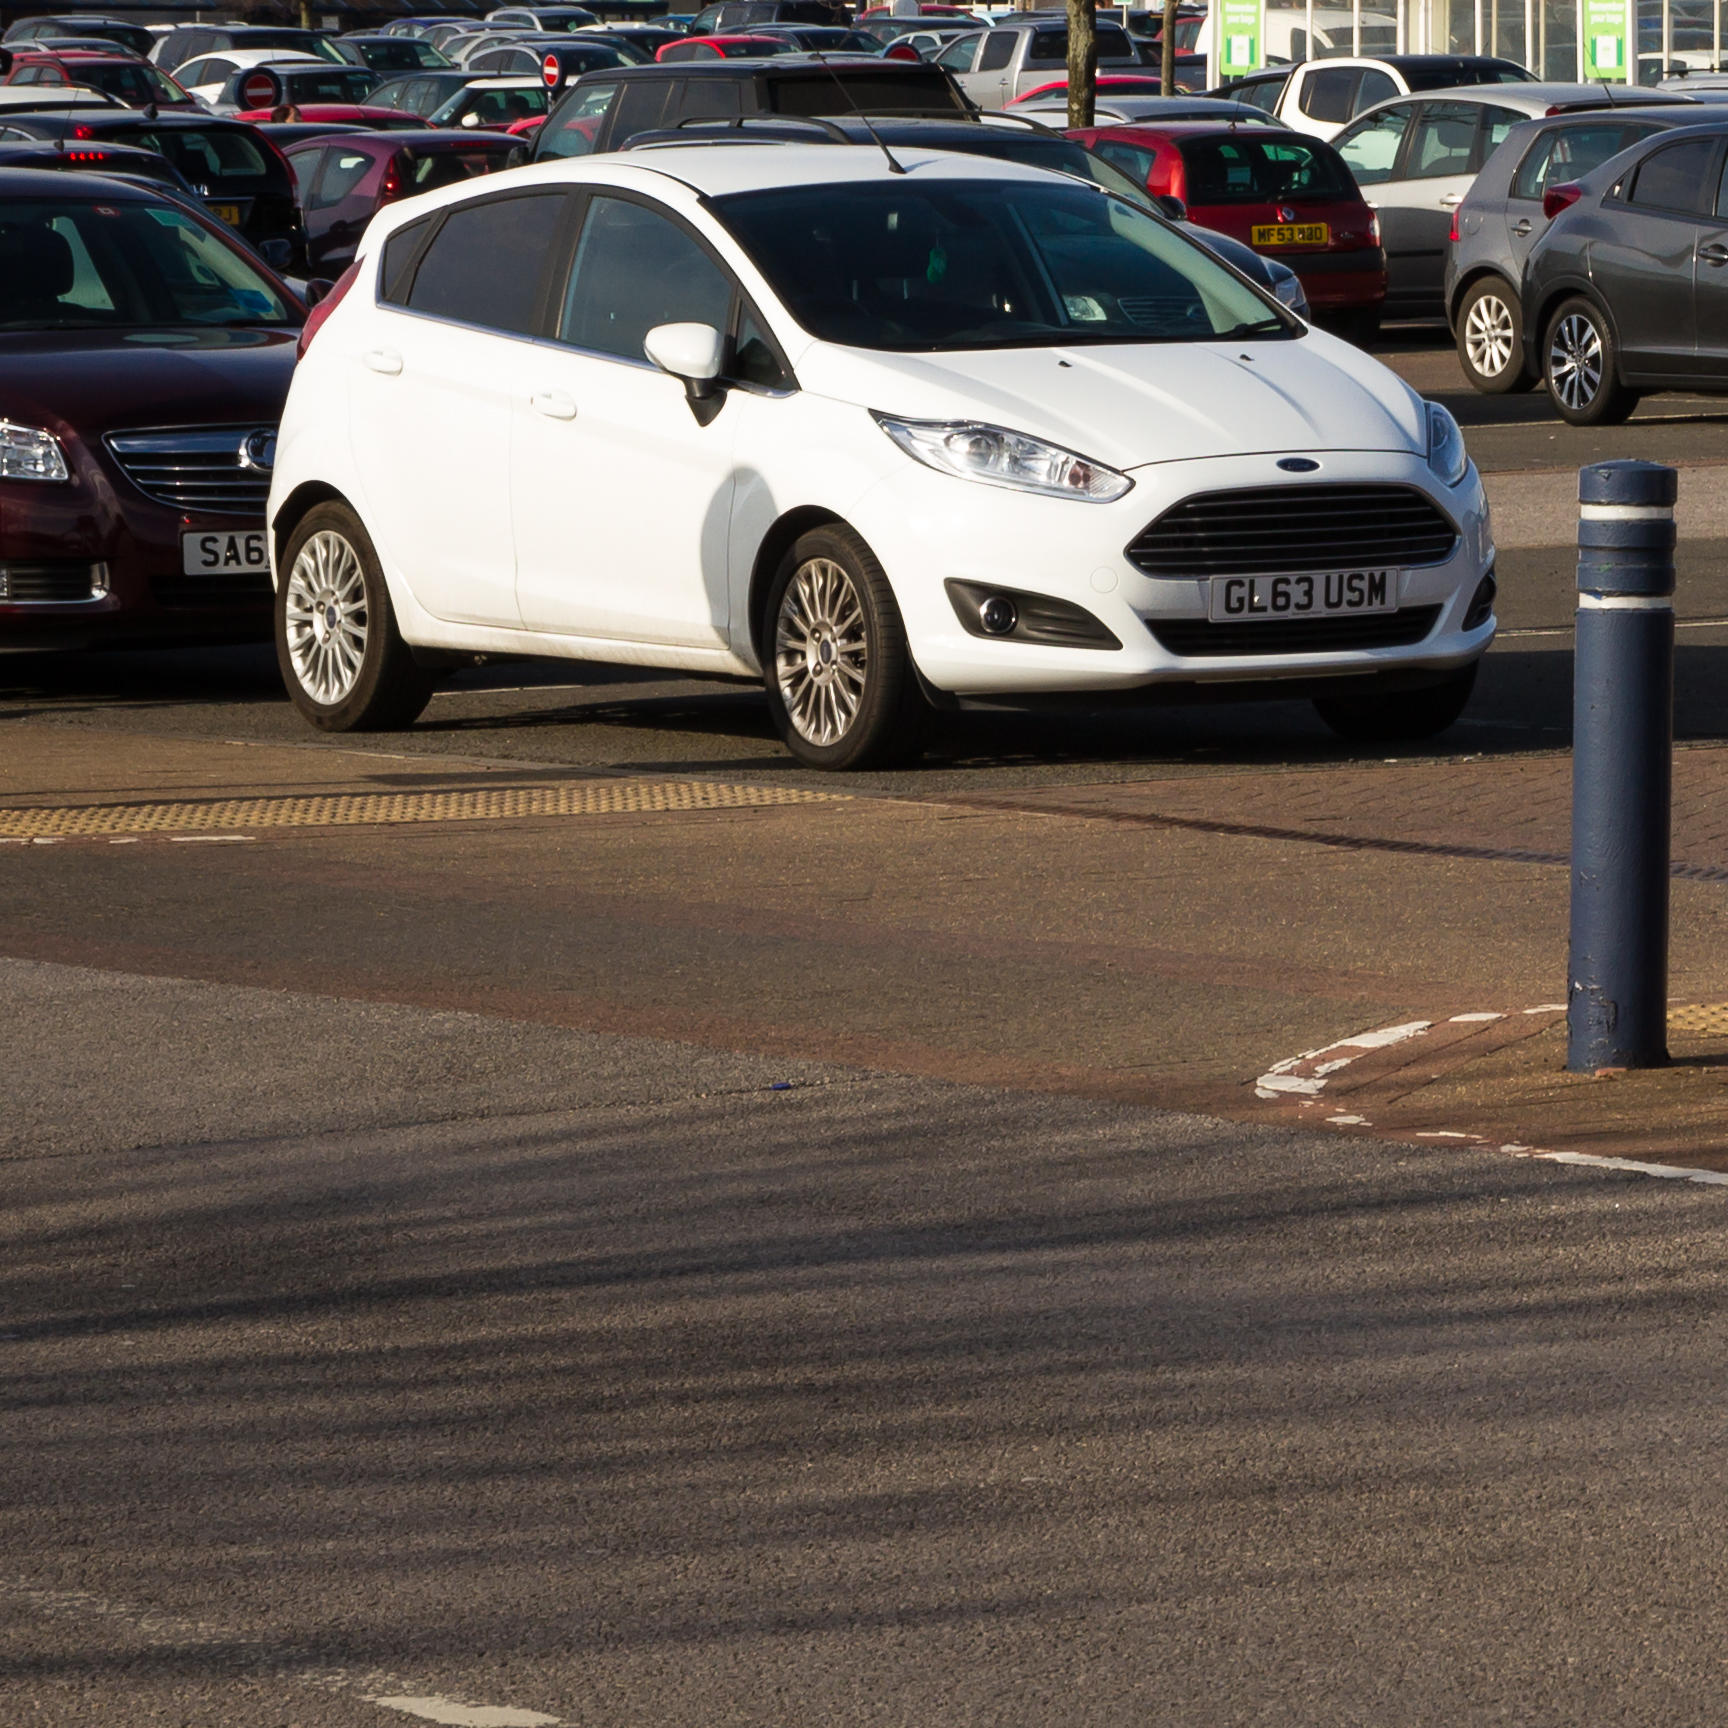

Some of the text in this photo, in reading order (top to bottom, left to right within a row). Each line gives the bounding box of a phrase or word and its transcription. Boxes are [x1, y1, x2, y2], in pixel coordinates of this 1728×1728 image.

[200, 534, 270, 569] SA6
[1225, 571, 1387, 614] GL63 USM
